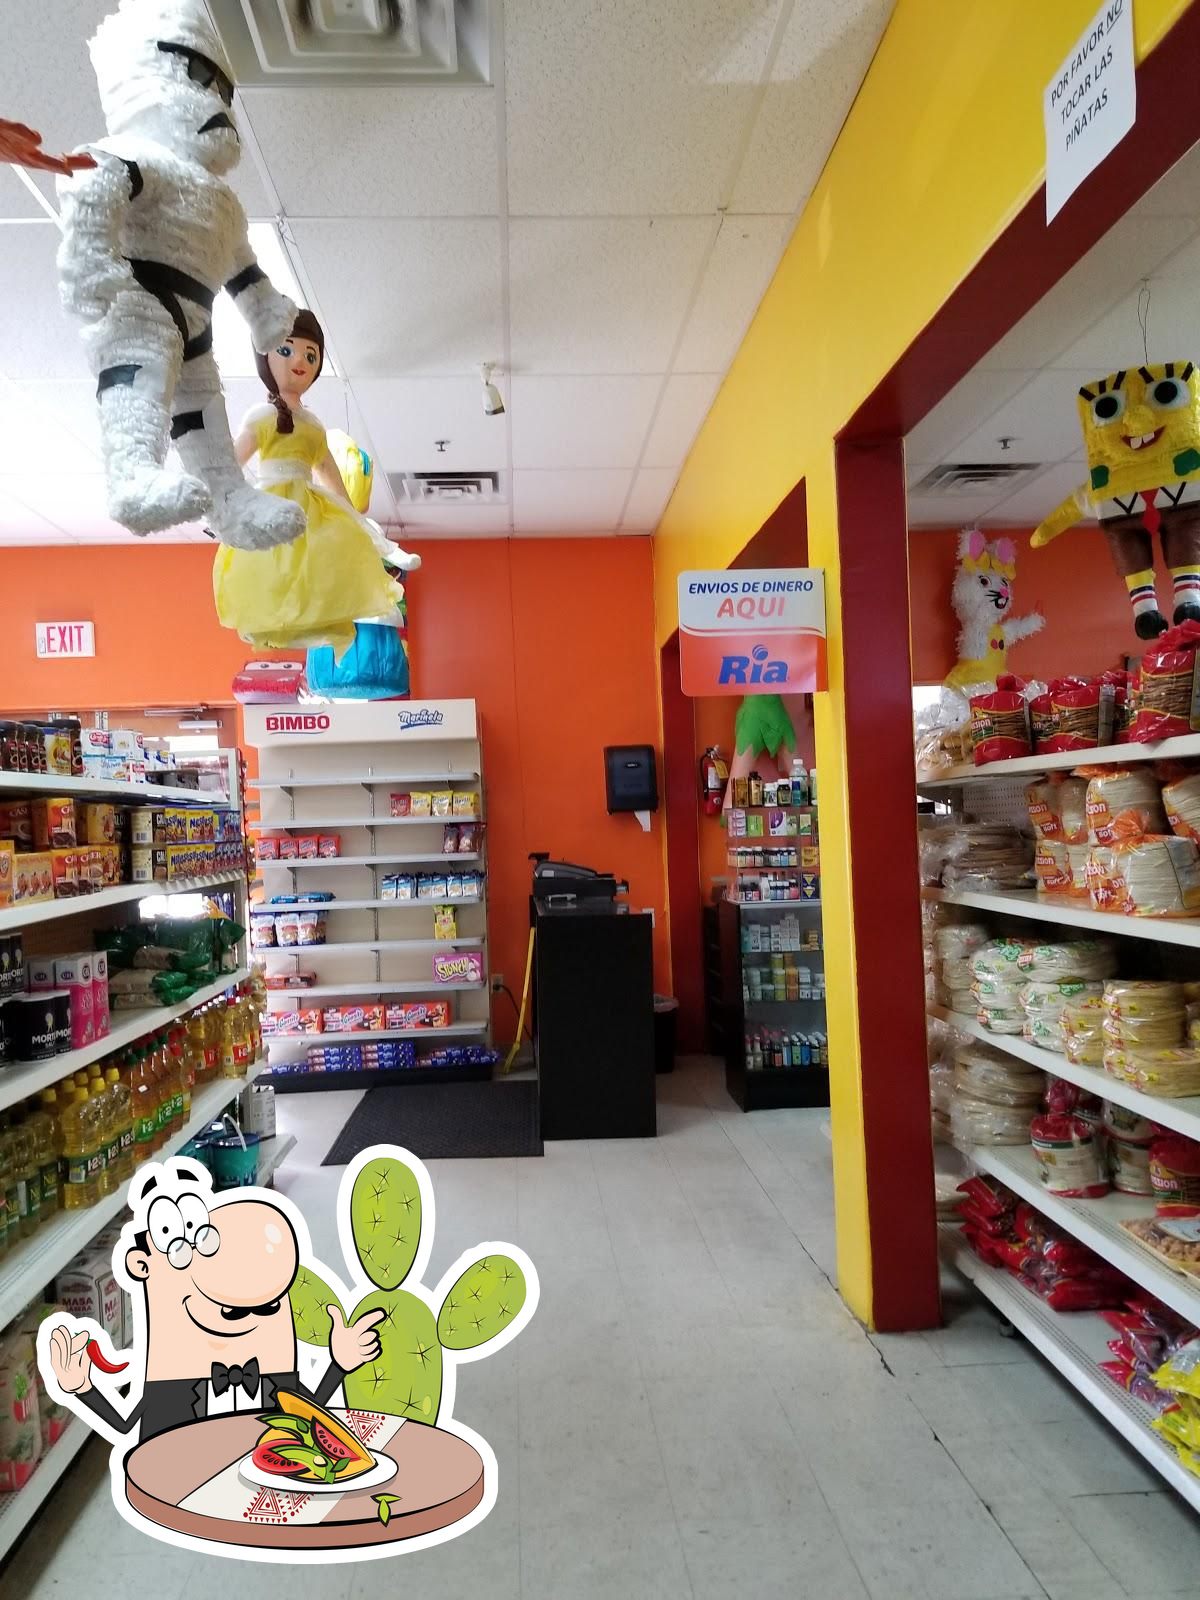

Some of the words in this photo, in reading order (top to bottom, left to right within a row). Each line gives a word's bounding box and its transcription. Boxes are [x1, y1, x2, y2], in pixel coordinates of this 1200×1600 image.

[1051, 72, 1069, 108] POR
[1071, 27, 1104, 78] FAVOR
[1106, 0, 1123, 28] NO
[1060, 76, 1091, 125] TOCAR
[1094, 45, 1113, 81] LAS
[1065, 87, 1108, 152] PIÑATAS
[689, 582, 739, 594] ENVIOS
[742, 581, 760, 593] DE
[762, 580, 813, 592] DINERO
[717, 596, 785, 619] AQUI
[46, 626, 84, 653] EXIT
[718, 644, 788, 685] Ria
[266, 715, 330, 731] BIMBO
[398, 710, 443, 724] Marinela
[62, 1297, 93, 1306] MASA
